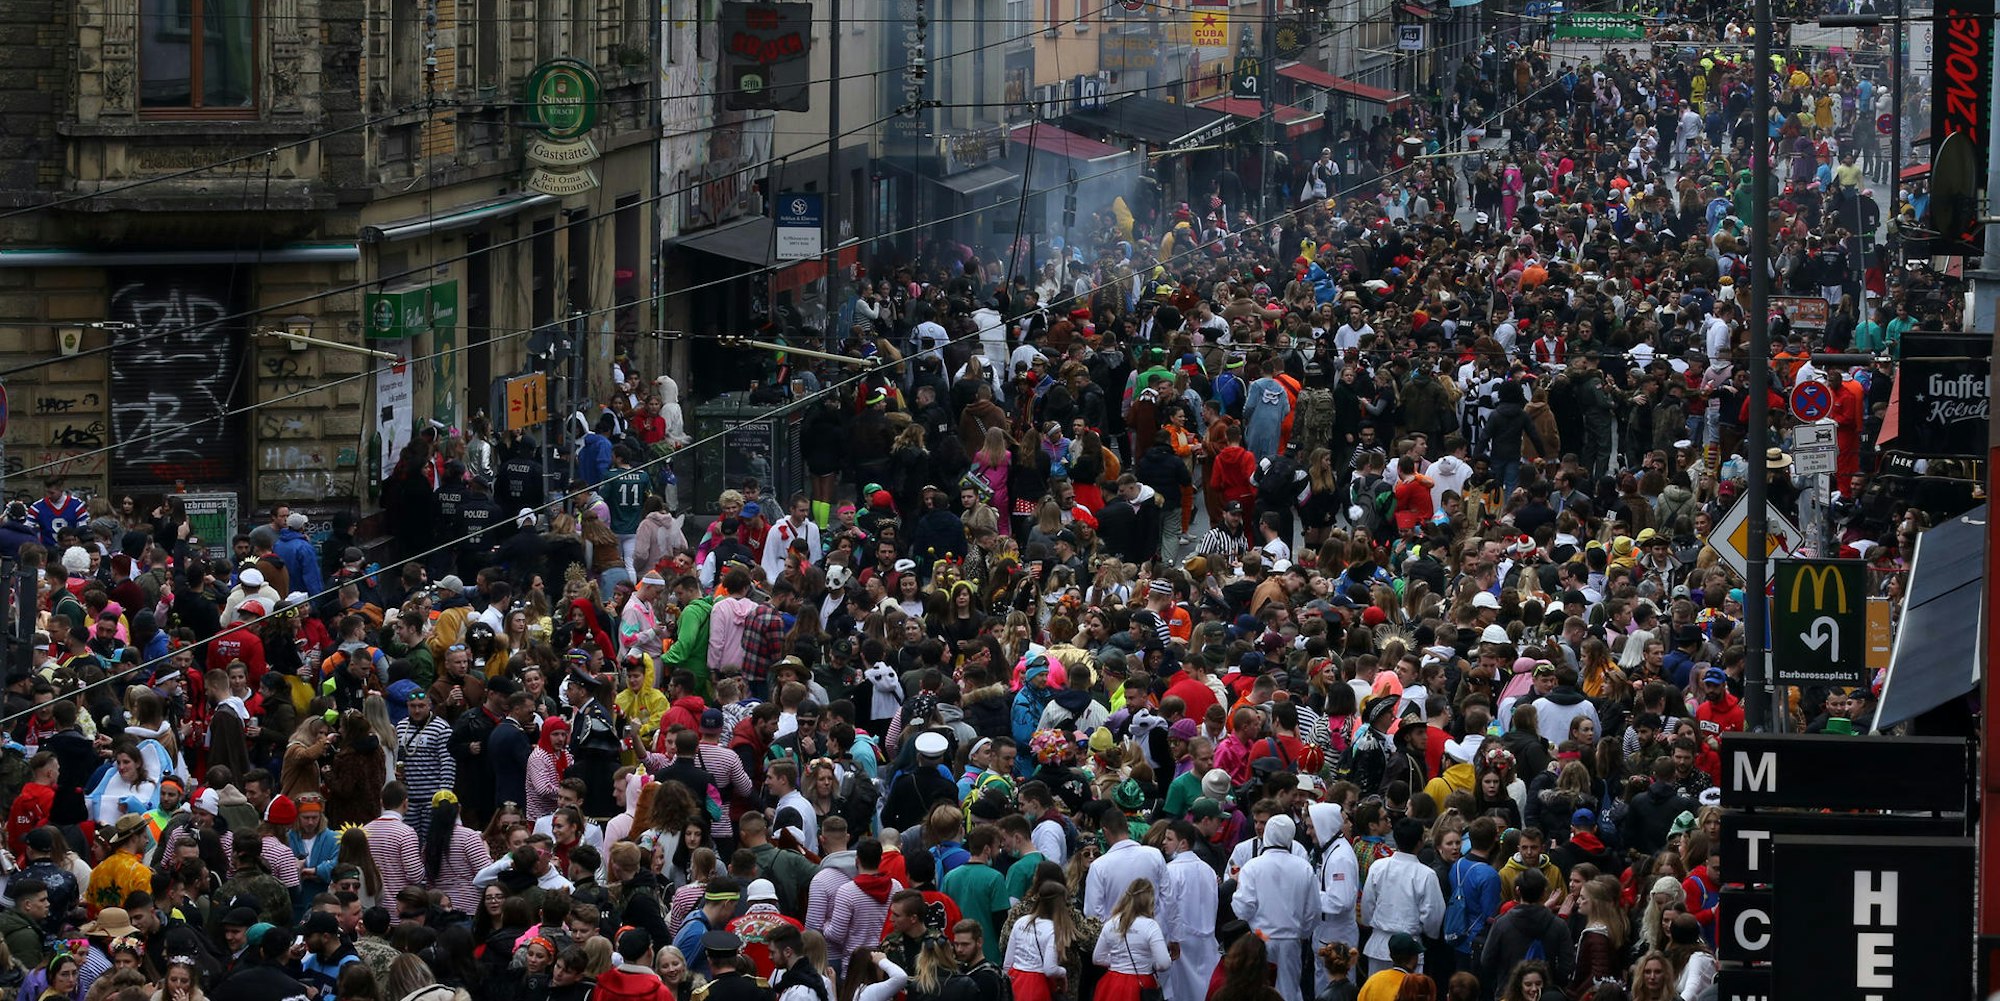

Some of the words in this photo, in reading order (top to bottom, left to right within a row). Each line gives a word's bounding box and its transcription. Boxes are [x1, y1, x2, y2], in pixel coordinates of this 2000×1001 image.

[1194, 30, 1224, 38] CUBA
[1199, 38, 1221, 46] BAR
[1104, 55, 1155, 67] SALON
[534, 144, 588, 160] Gaststätte
[541, 173, 556, 183] Bei
[558, 176, 581, 184] Oma
[532, 179, 590, 193] Kleinmann
[1929, 373, 1990, 399] Gaffel
[1926, 400, 1988, 425] Kölsch
[507, 464, 530, 473] POLIZEI
[439, 493, 461, 502] POLIZEI
[618, 484, 641, 506] 11
[464, 510, 489, 518] POLIZEI
[1779, 670, 1852, 680] Barbarossaplatz
[1853, 671, 1859, 680] 1
[1733, 751, 1776, 792] M
[1737, 830, 1770, 870] T
[1734, 909, 1771, 950] C
[1853, 870, 1898, 1001] HE
